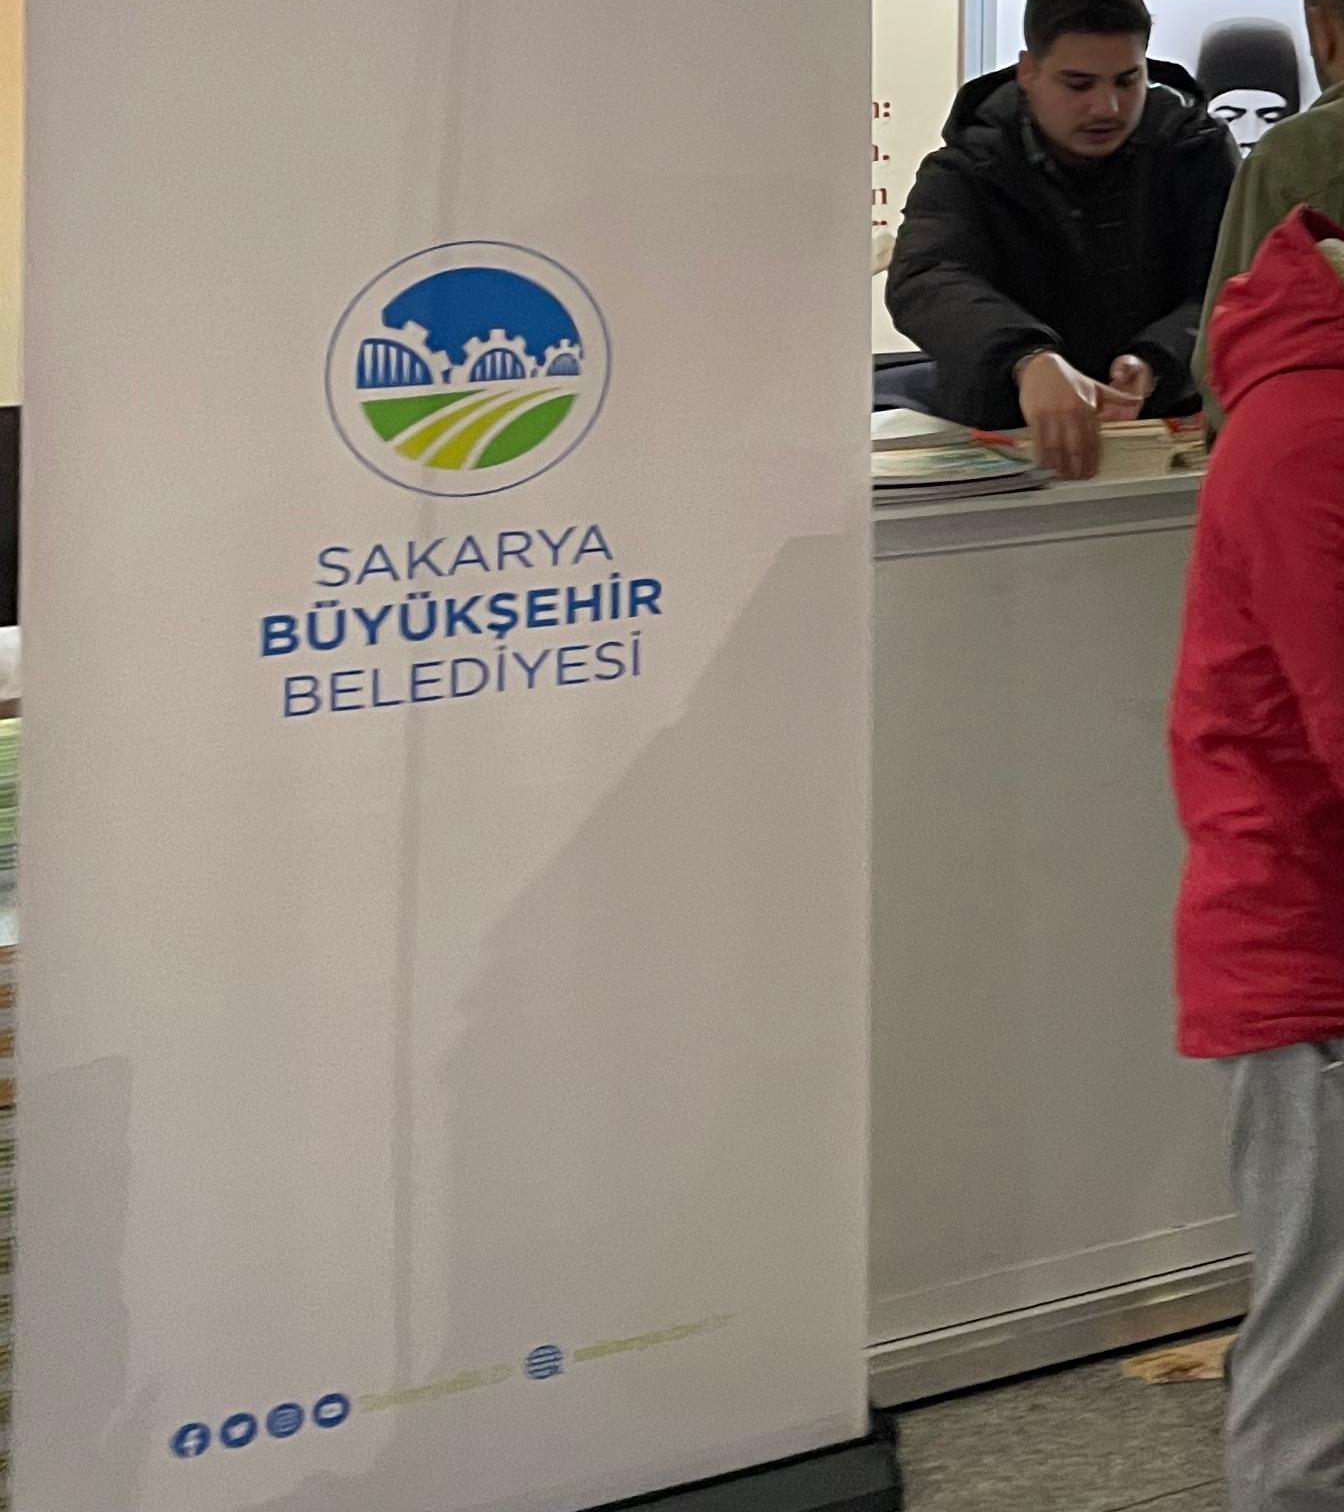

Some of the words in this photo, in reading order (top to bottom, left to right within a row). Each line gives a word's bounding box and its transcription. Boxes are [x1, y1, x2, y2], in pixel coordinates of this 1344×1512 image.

[314, 523, 614, 588] SAKARYA
[260, 572, 664, 658] BÜYÜKŞEHİR
[282, 630, 642, 717] BELEDİYESİ
